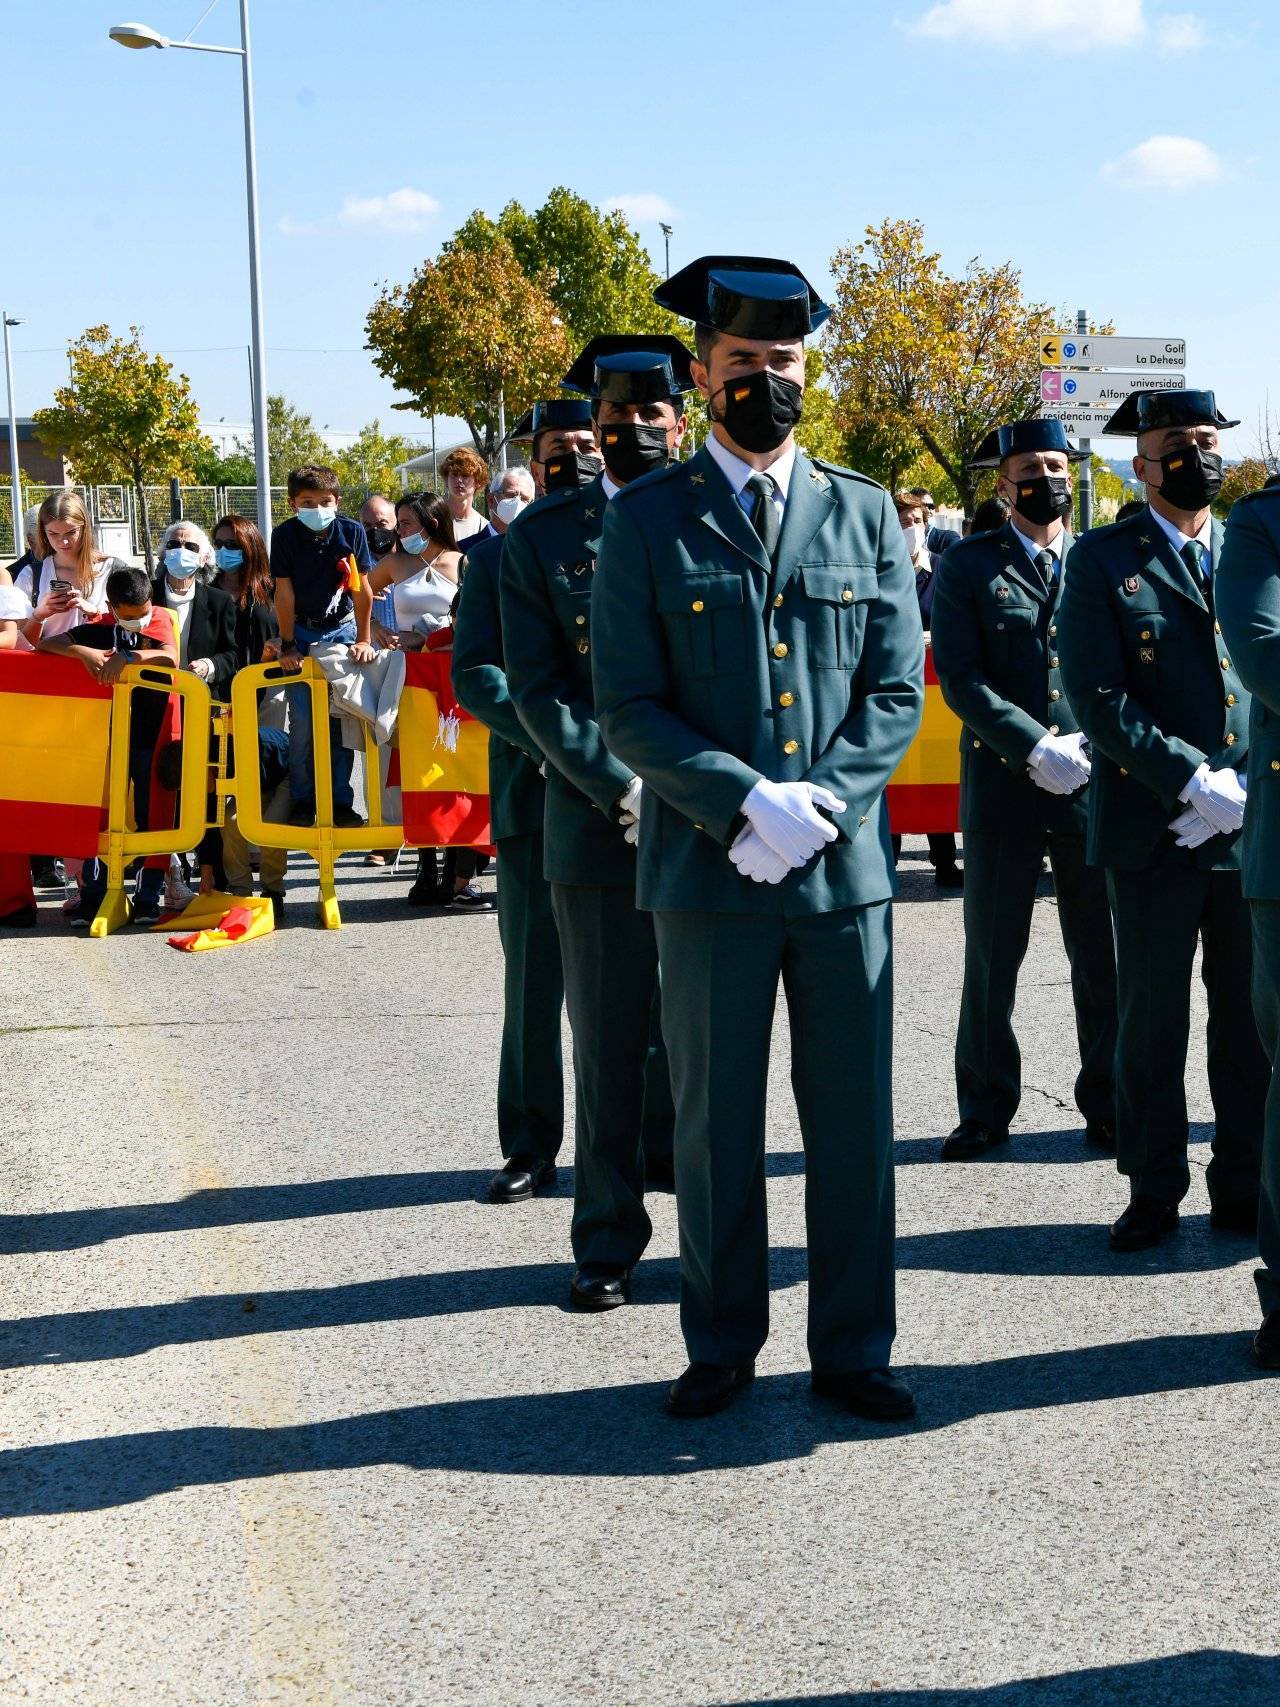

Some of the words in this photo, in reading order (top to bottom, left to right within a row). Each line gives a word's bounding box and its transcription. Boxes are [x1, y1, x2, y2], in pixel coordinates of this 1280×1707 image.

[1164, 343, 1185, 353] Golf
[1136, 355, 1147, 364] La
[1150, 355, 1184, 365] Dehesa
[1130, 378, 1184, 389] universidad
[1099, 389, 1130, 399] Alfons
[1043, 411, 1092, 421] residencia
